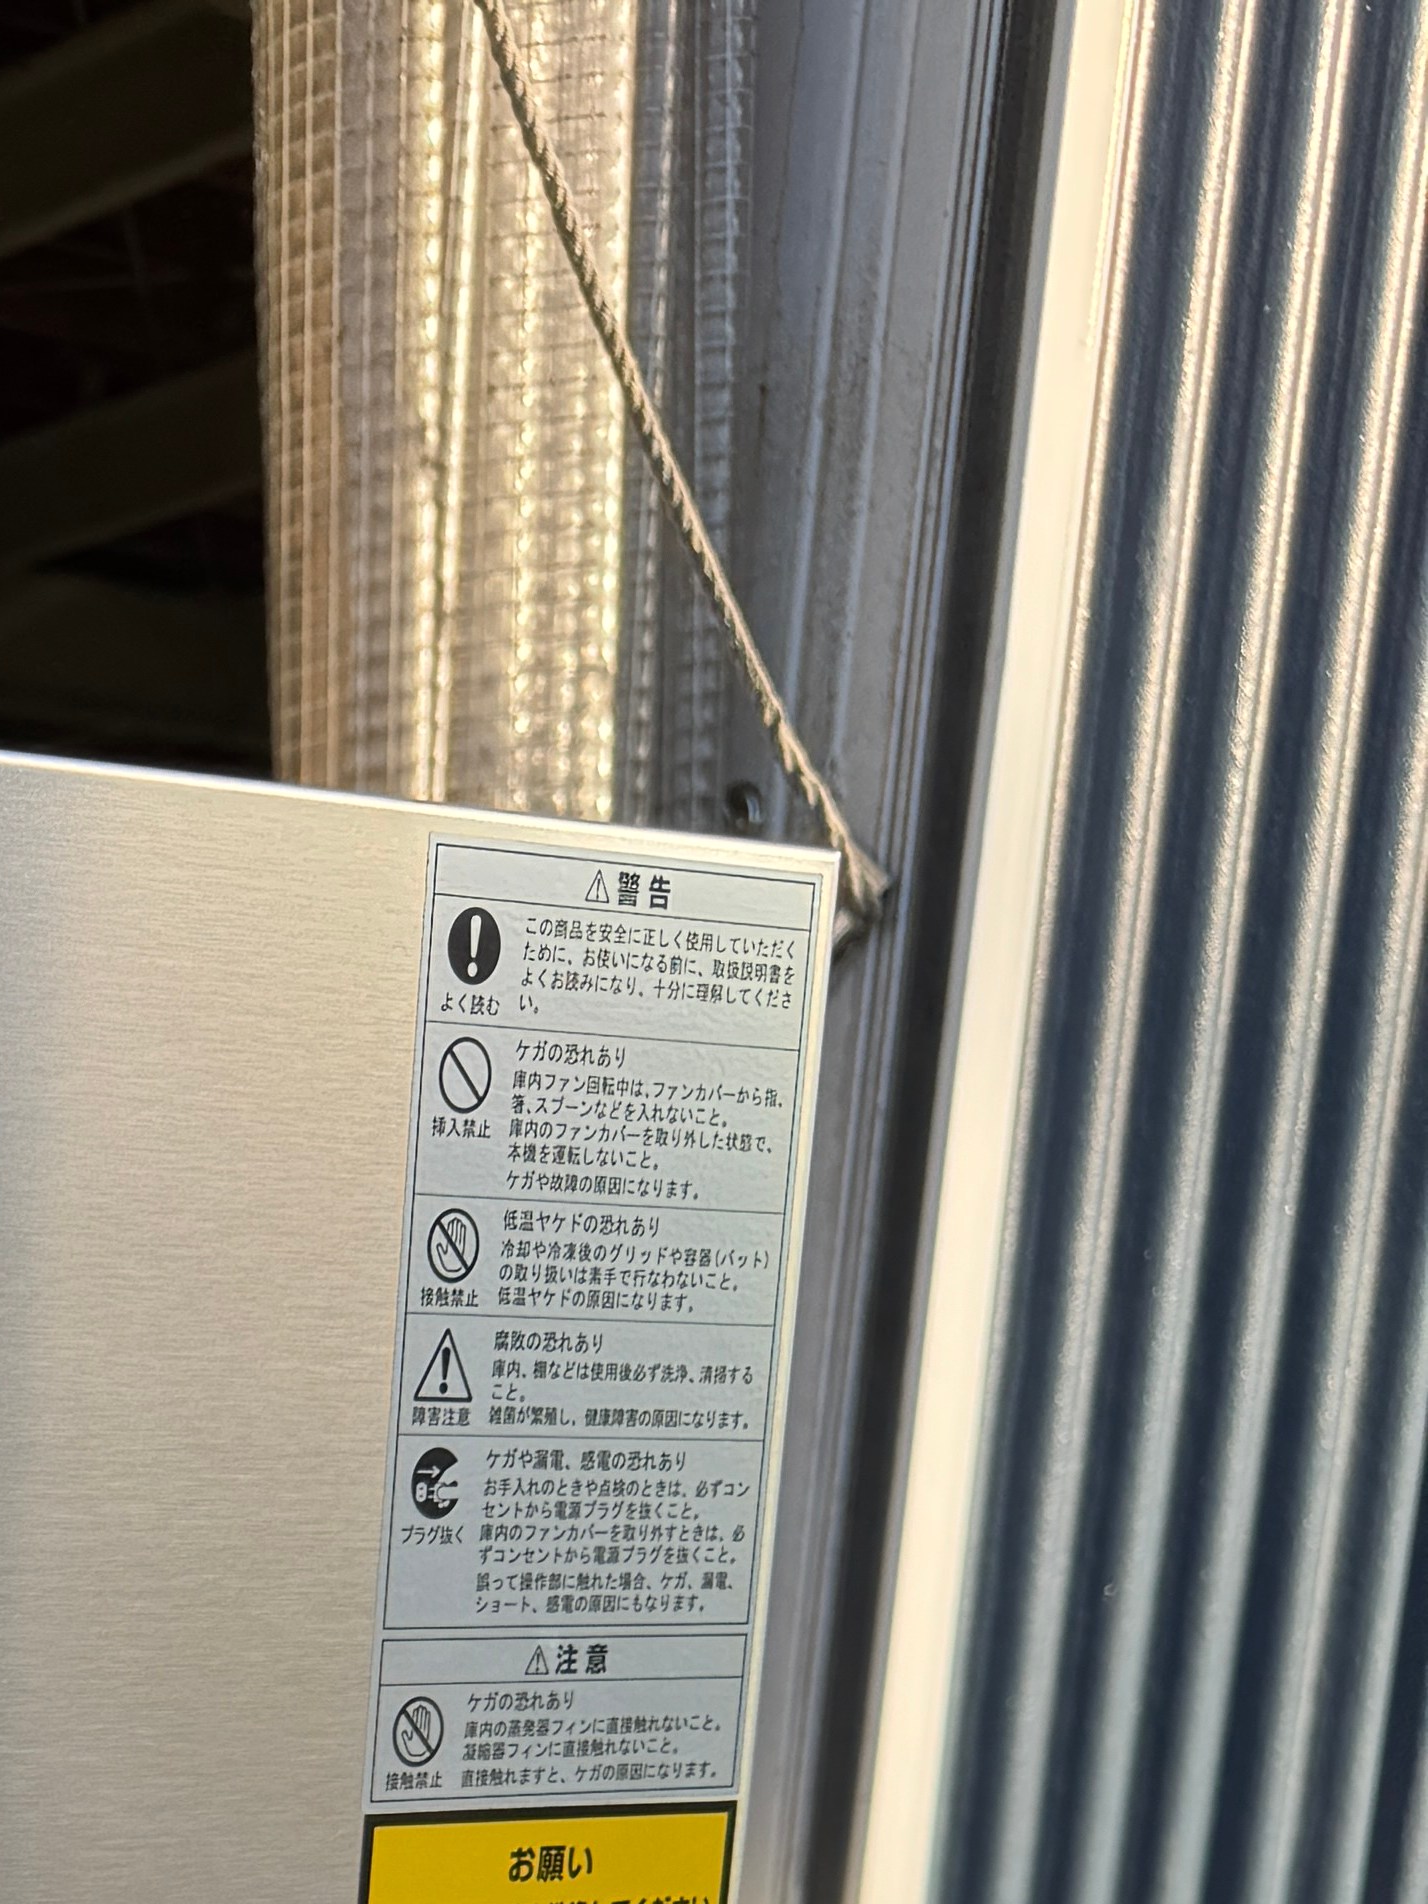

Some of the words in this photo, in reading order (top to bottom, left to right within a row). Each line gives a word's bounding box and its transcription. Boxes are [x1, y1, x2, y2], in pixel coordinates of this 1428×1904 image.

[618, 871, 671, 910] 警告
[440, 994, 499, 1016] よく読む
[519, 996, 540, 1014] い。
[515, 1040, 626, 1067] ケガの恐れあり
[432, 1116, 490, 1139] 挿入禁止
[503, 1210, 660, 1237] 低温ヤケドの恐れあり
[420, 1286, 479, 1308] 接触禁止
[494, 1330, 604, 1354] 腐敗の恐れあり
[491, 1383, 527, 1403] こと。
[412, 1406, 471, 1428] 障害注意
[400, 1525, 465, 1546] プラグ抜く
[555, 1643, 608, 1675] 注意
[466, 1690, 575, 1713] ケガの恐れあり
[385, 1770, 442, 1792] 接触禁止
[508, 1844, 593, 1882] お願い
